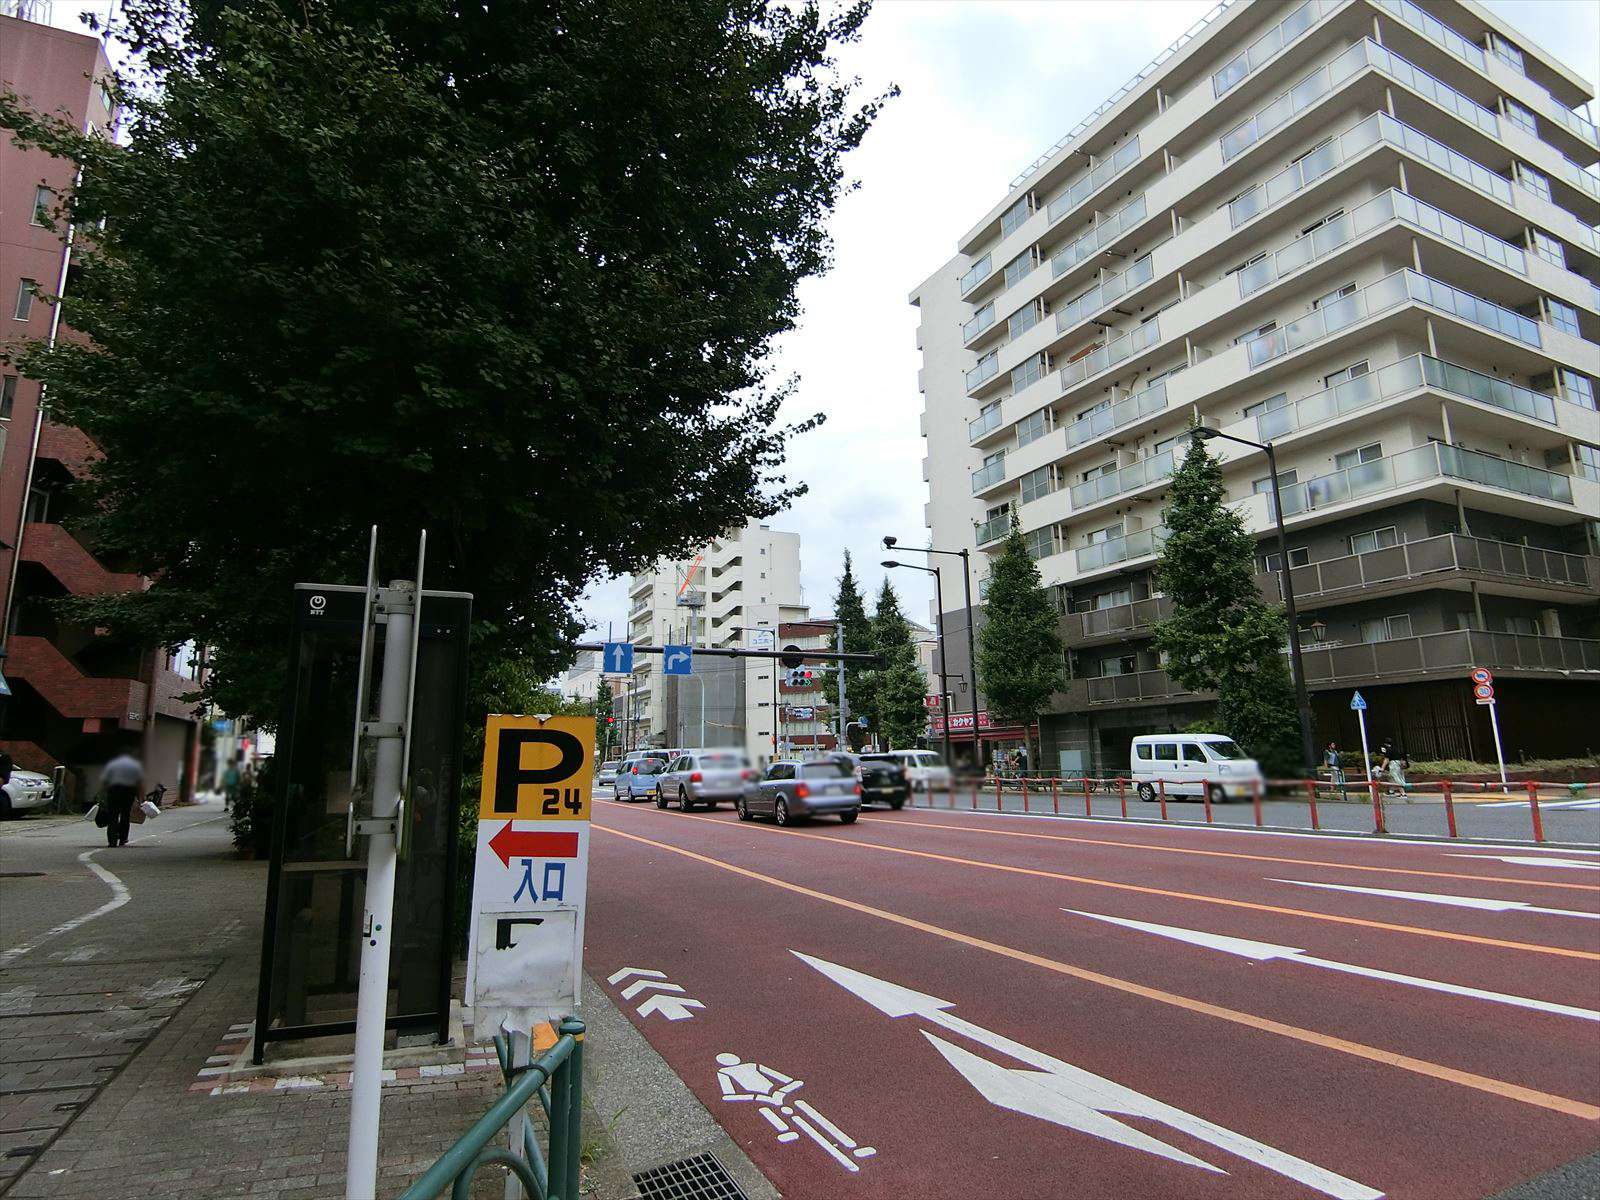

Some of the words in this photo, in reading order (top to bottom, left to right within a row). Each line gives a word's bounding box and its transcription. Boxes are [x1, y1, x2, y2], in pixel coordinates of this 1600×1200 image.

[494, 728, 585, 813] P
[542, 788, 582, 815] 24
[513, 859, 566, 904] 入口
